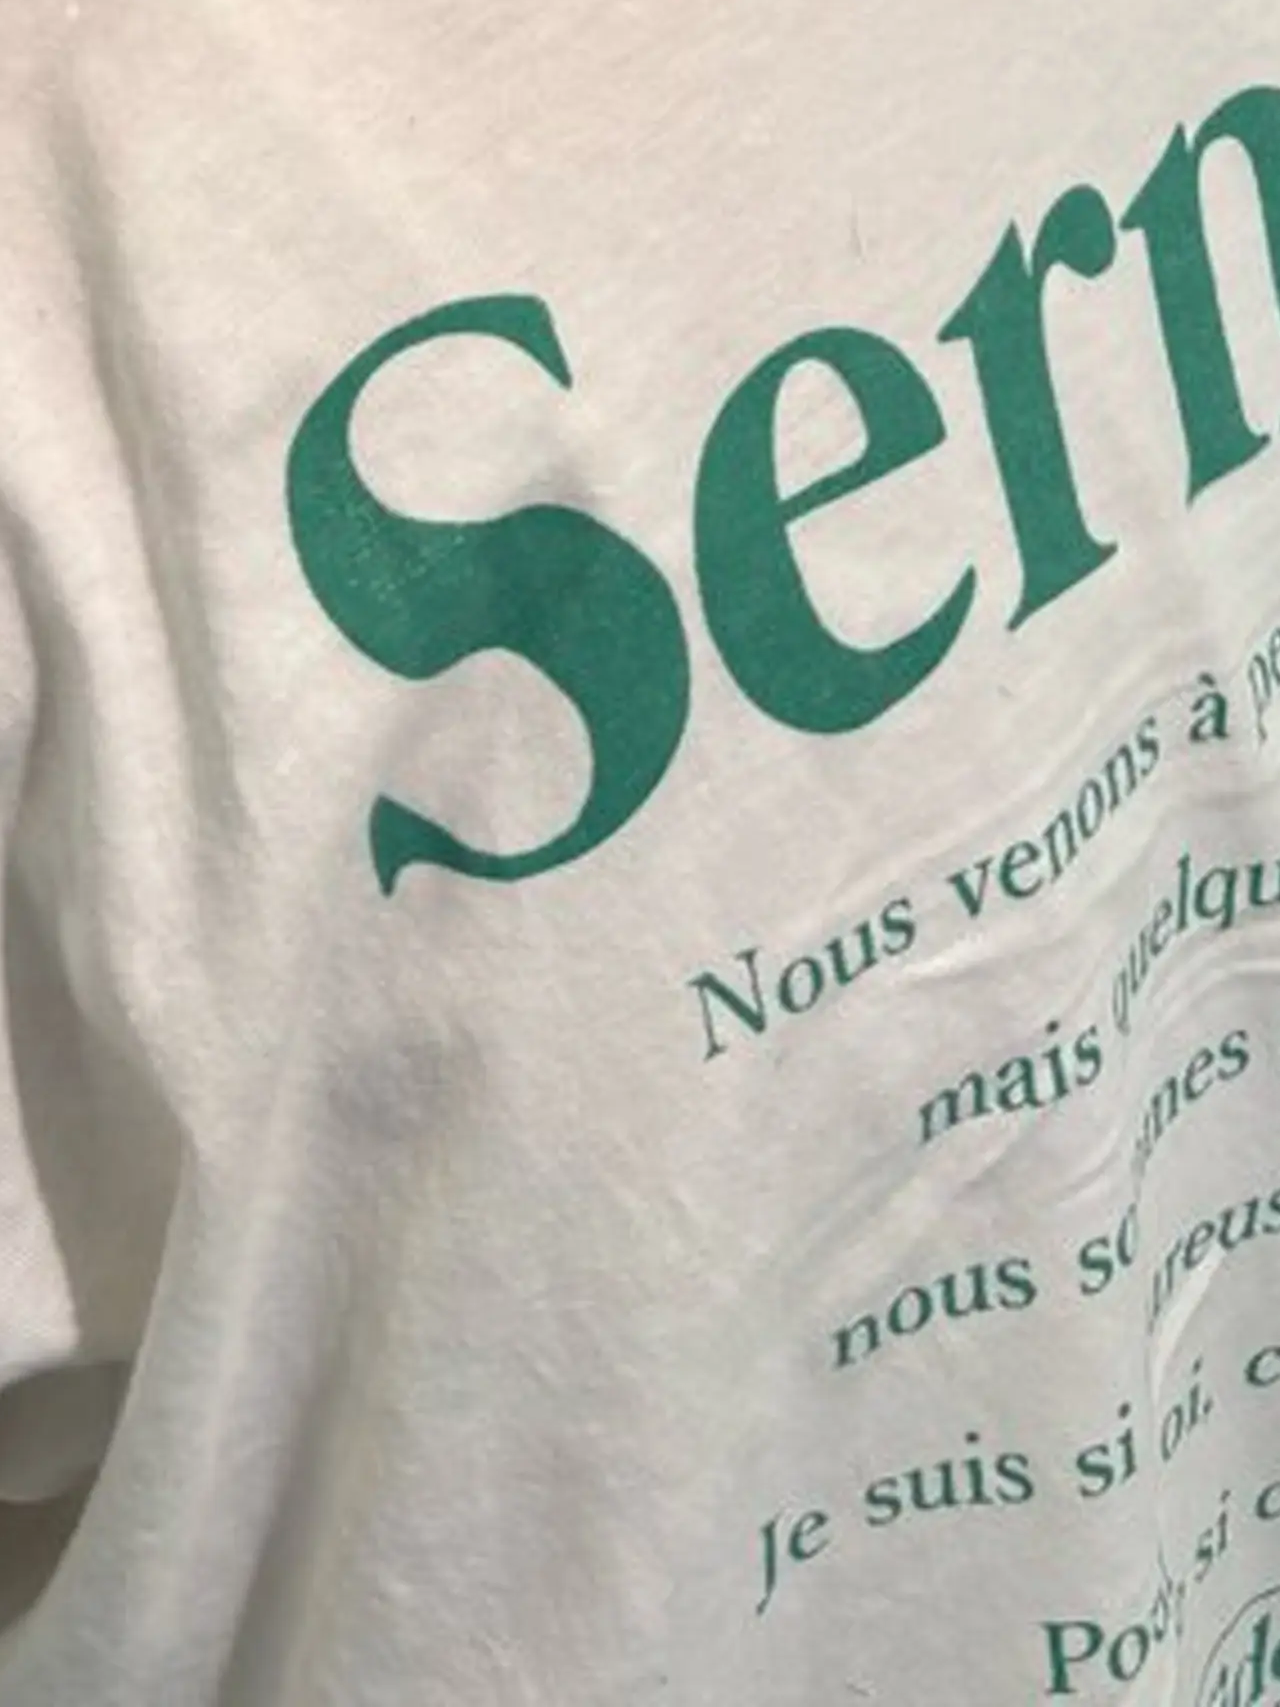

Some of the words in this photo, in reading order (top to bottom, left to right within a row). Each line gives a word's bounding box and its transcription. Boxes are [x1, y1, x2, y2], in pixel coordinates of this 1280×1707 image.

[686, 895, 917, 1061] Nous
[946, 713, 1162, 919] venons
[1186, 672, 1230, 744] à
[919, 1020, 1105, 1146] mais
[831, 1251, 1039, 1371] nous
[756, 1502, 830, 1615] Je
[863, 1432, 1035, 1530] suis
[1075, 1403, 1138, 1499] si
